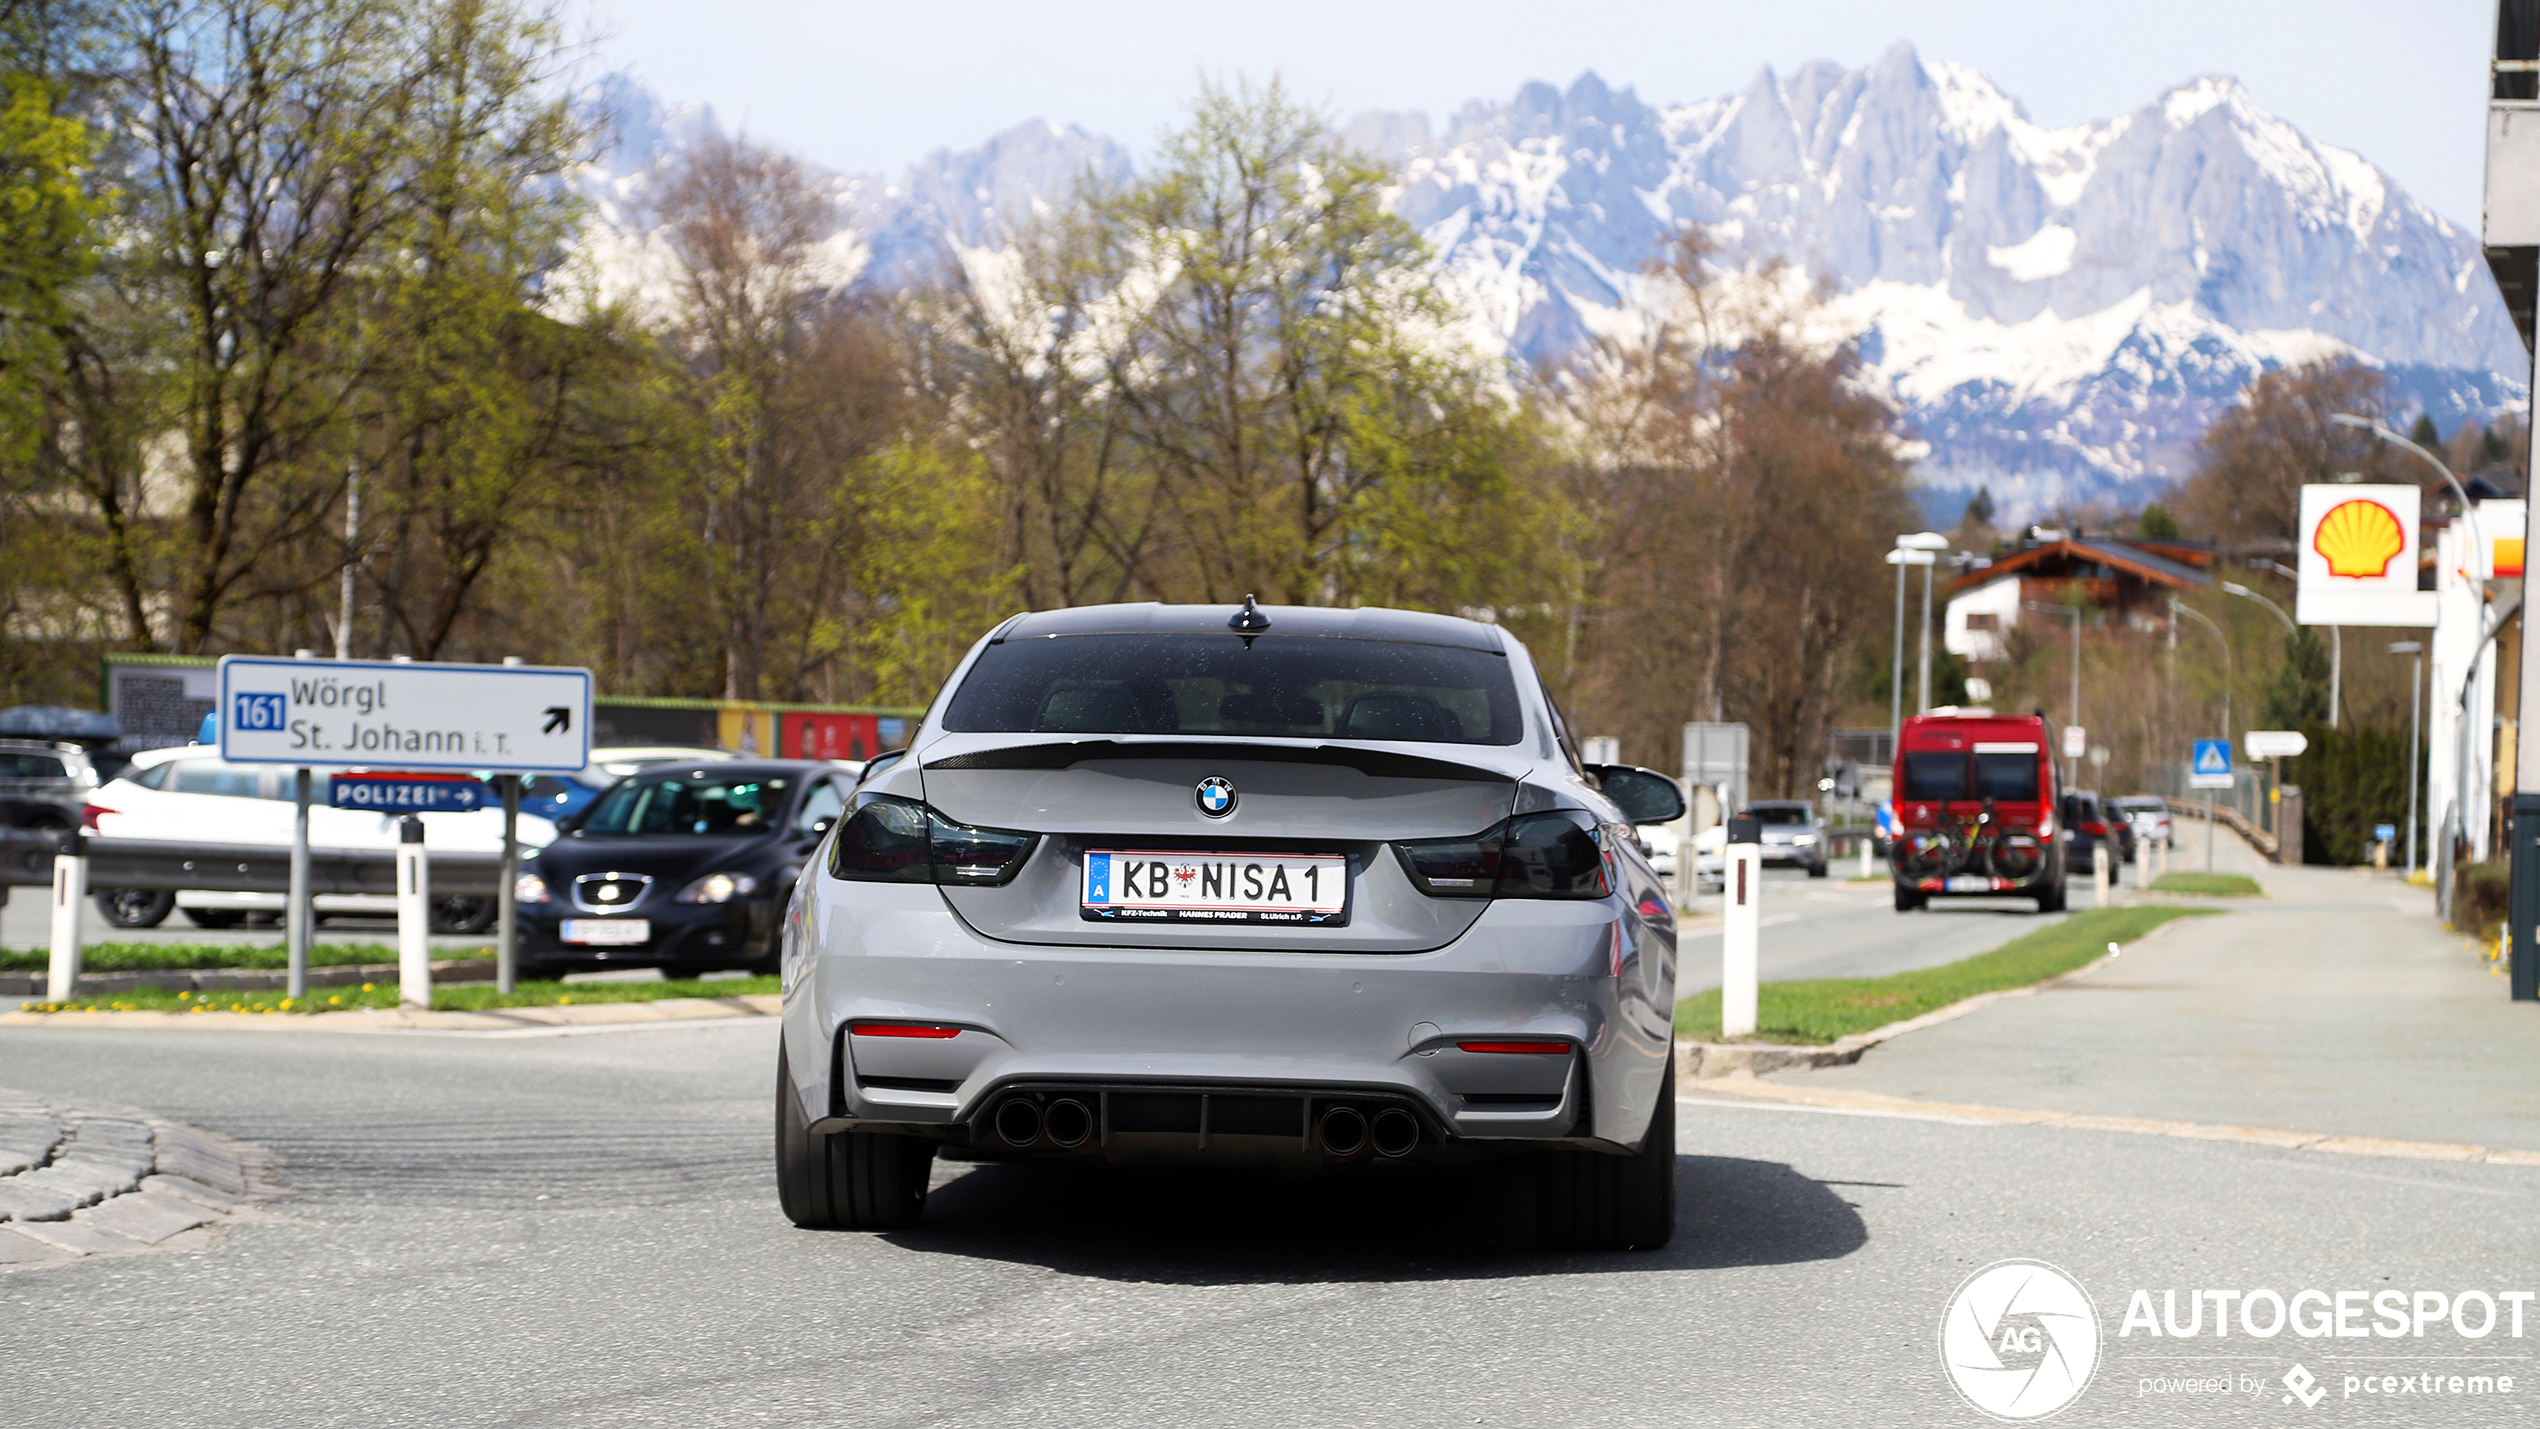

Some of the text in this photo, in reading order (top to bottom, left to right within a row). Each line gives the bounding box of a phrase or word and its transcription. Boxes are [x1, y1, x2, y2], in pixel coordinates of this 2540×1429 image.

[291, 677, 386, 715] Wörgl
[237, 695, 283, 729] 161
[290, 719, 513, 755] St. Johann i. T.
[336, 784, 437, 806] POLIZEI
[1199, 777, 1233, 792] BMW
[1093, 884, 1104, 897] A
[1123, 861, 1318, 902] KB NISA 1
[1121, 909, 1168, 918] KFZ-Technik
[1179, 910, 1213, 918] HANNES
[1214, 911, 1248, 919] PRADER
